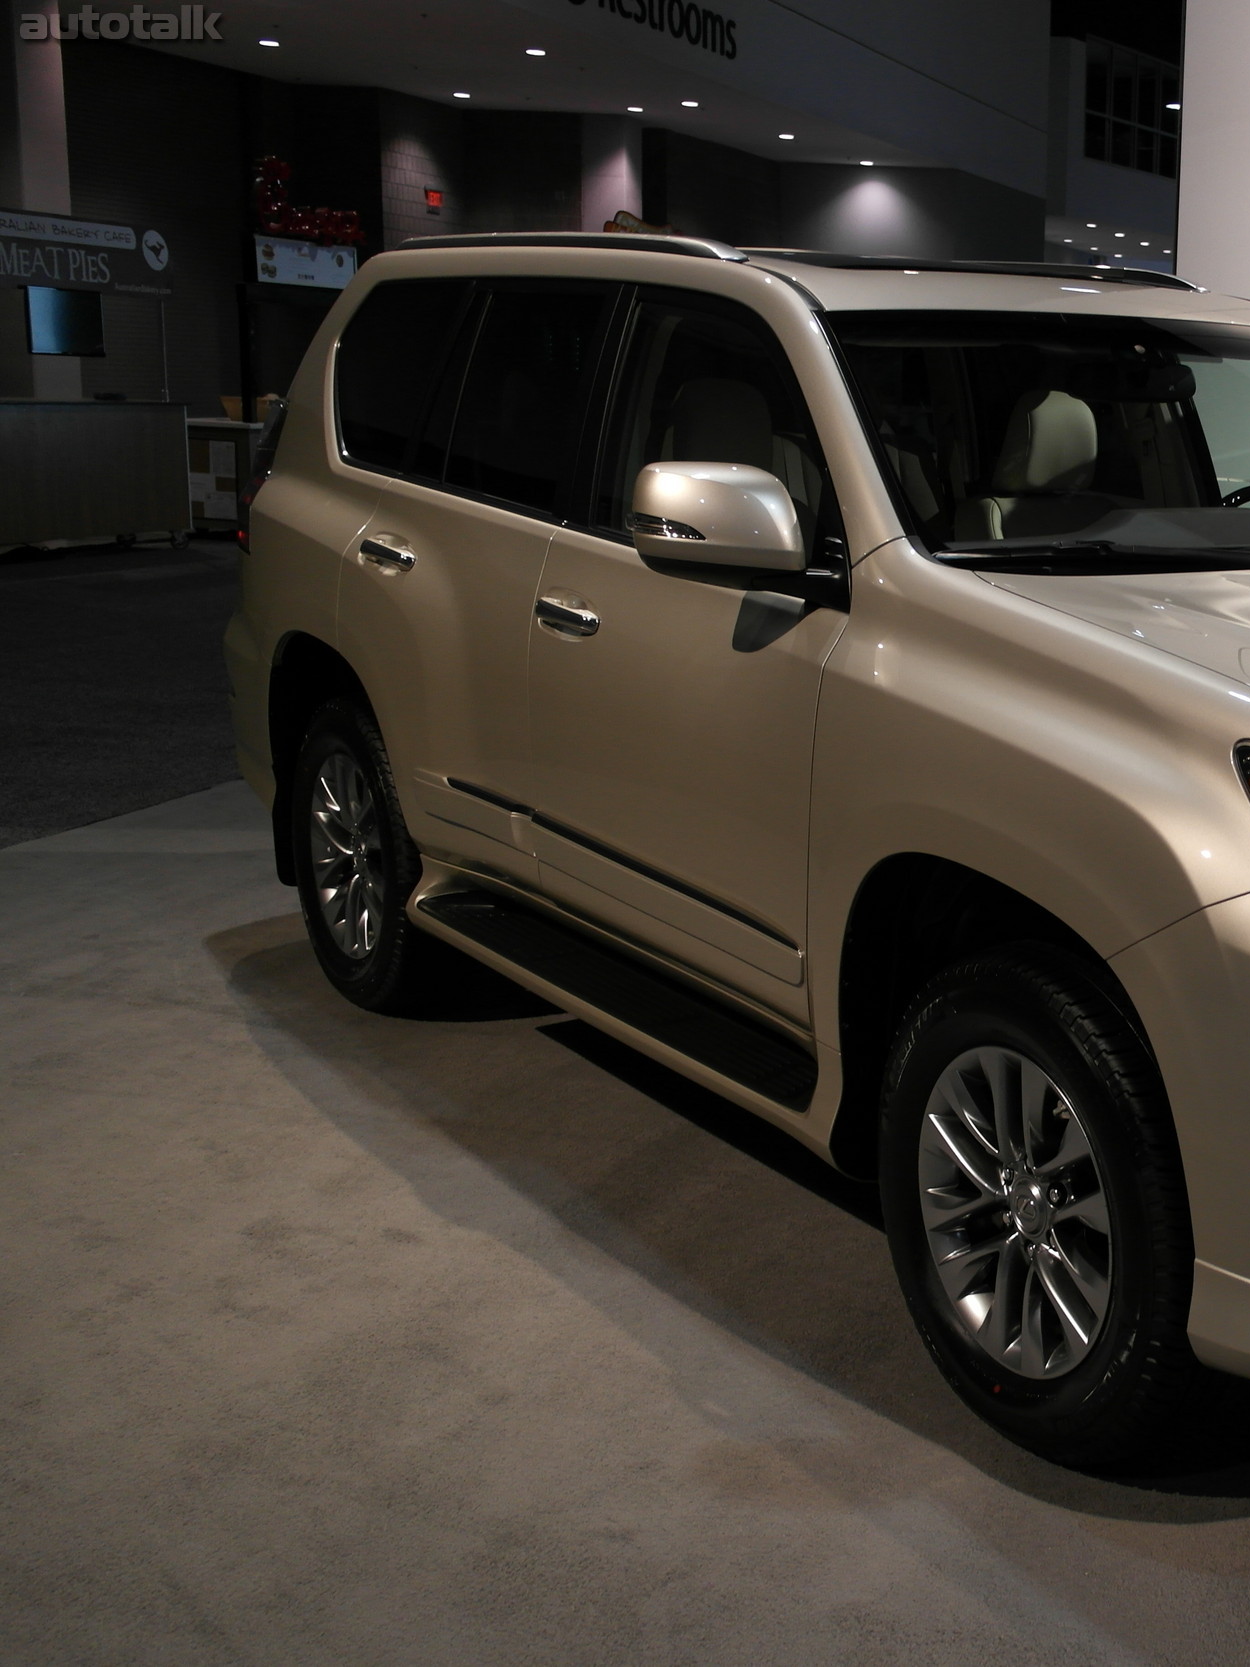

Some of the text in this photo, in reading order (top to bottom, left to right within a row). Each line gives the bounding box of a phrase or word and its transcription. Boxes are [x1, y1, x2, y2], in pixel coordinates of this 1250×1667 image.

[598, 0, 737, 60] strooms
[52, 224, 101, 240] BAKERY
[104, 231, 132, 244] CAFE
[0, 241, 111, 284] MEAT PIES
